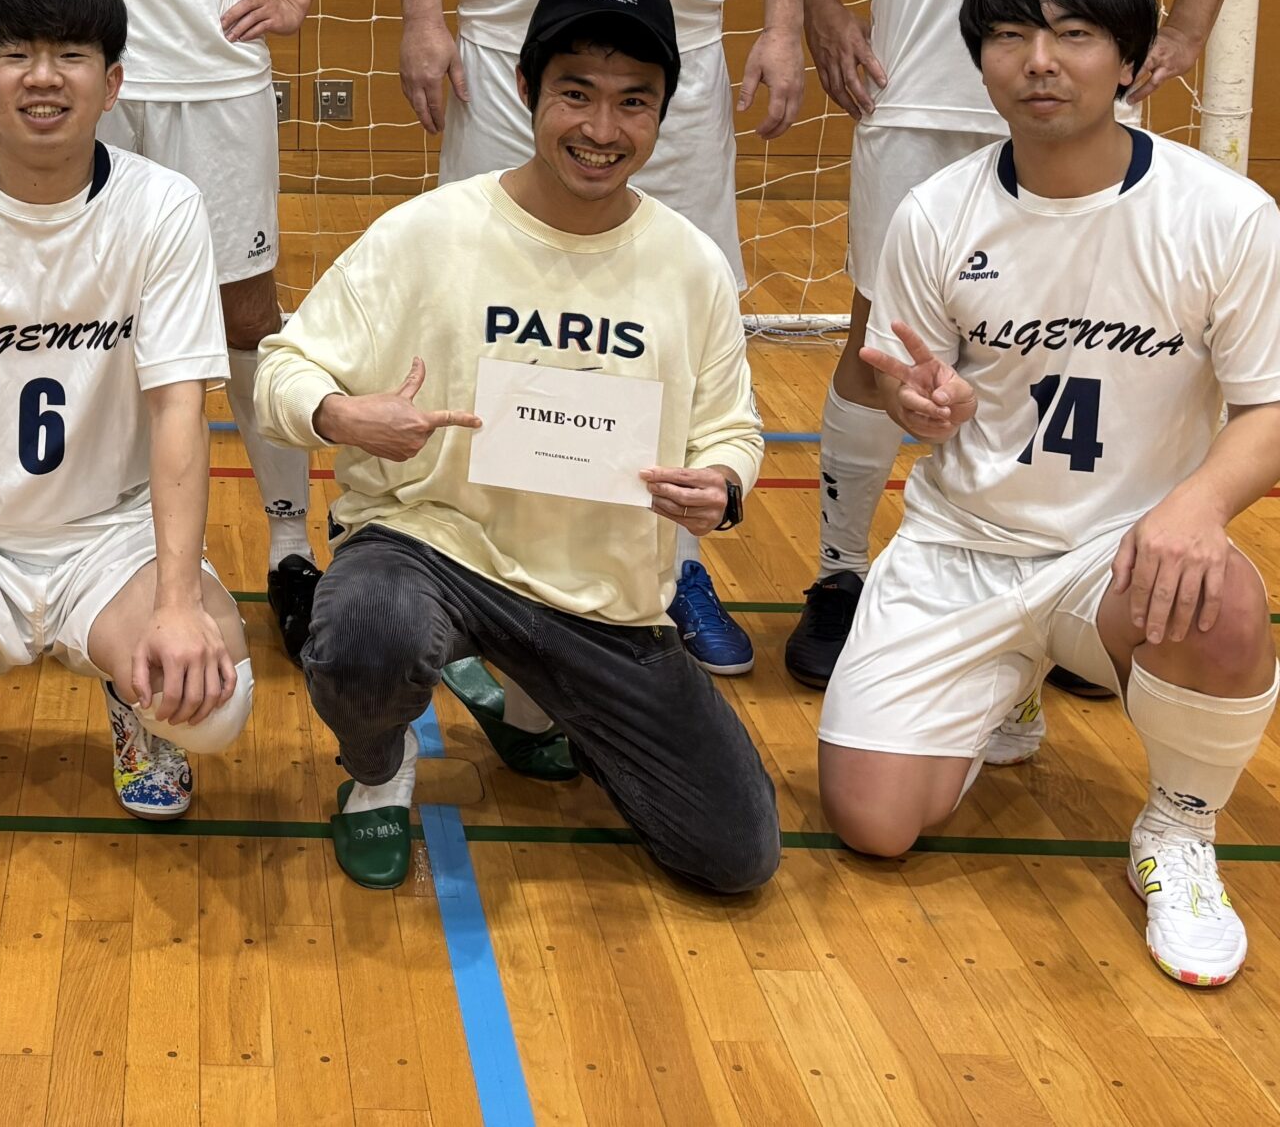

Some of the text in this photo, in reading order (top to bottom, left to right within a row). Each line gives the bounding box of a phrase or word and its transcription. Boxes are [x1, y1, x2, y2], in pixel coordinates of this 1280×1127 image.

[959, 269, 999, 282] Desporte
[485, 306, 645, 359] PARIS
[18, 377, 66, 476] 6
[516, 406, 616, 432] TIME-OUT
[1016, 374, 1104, 473] 14
